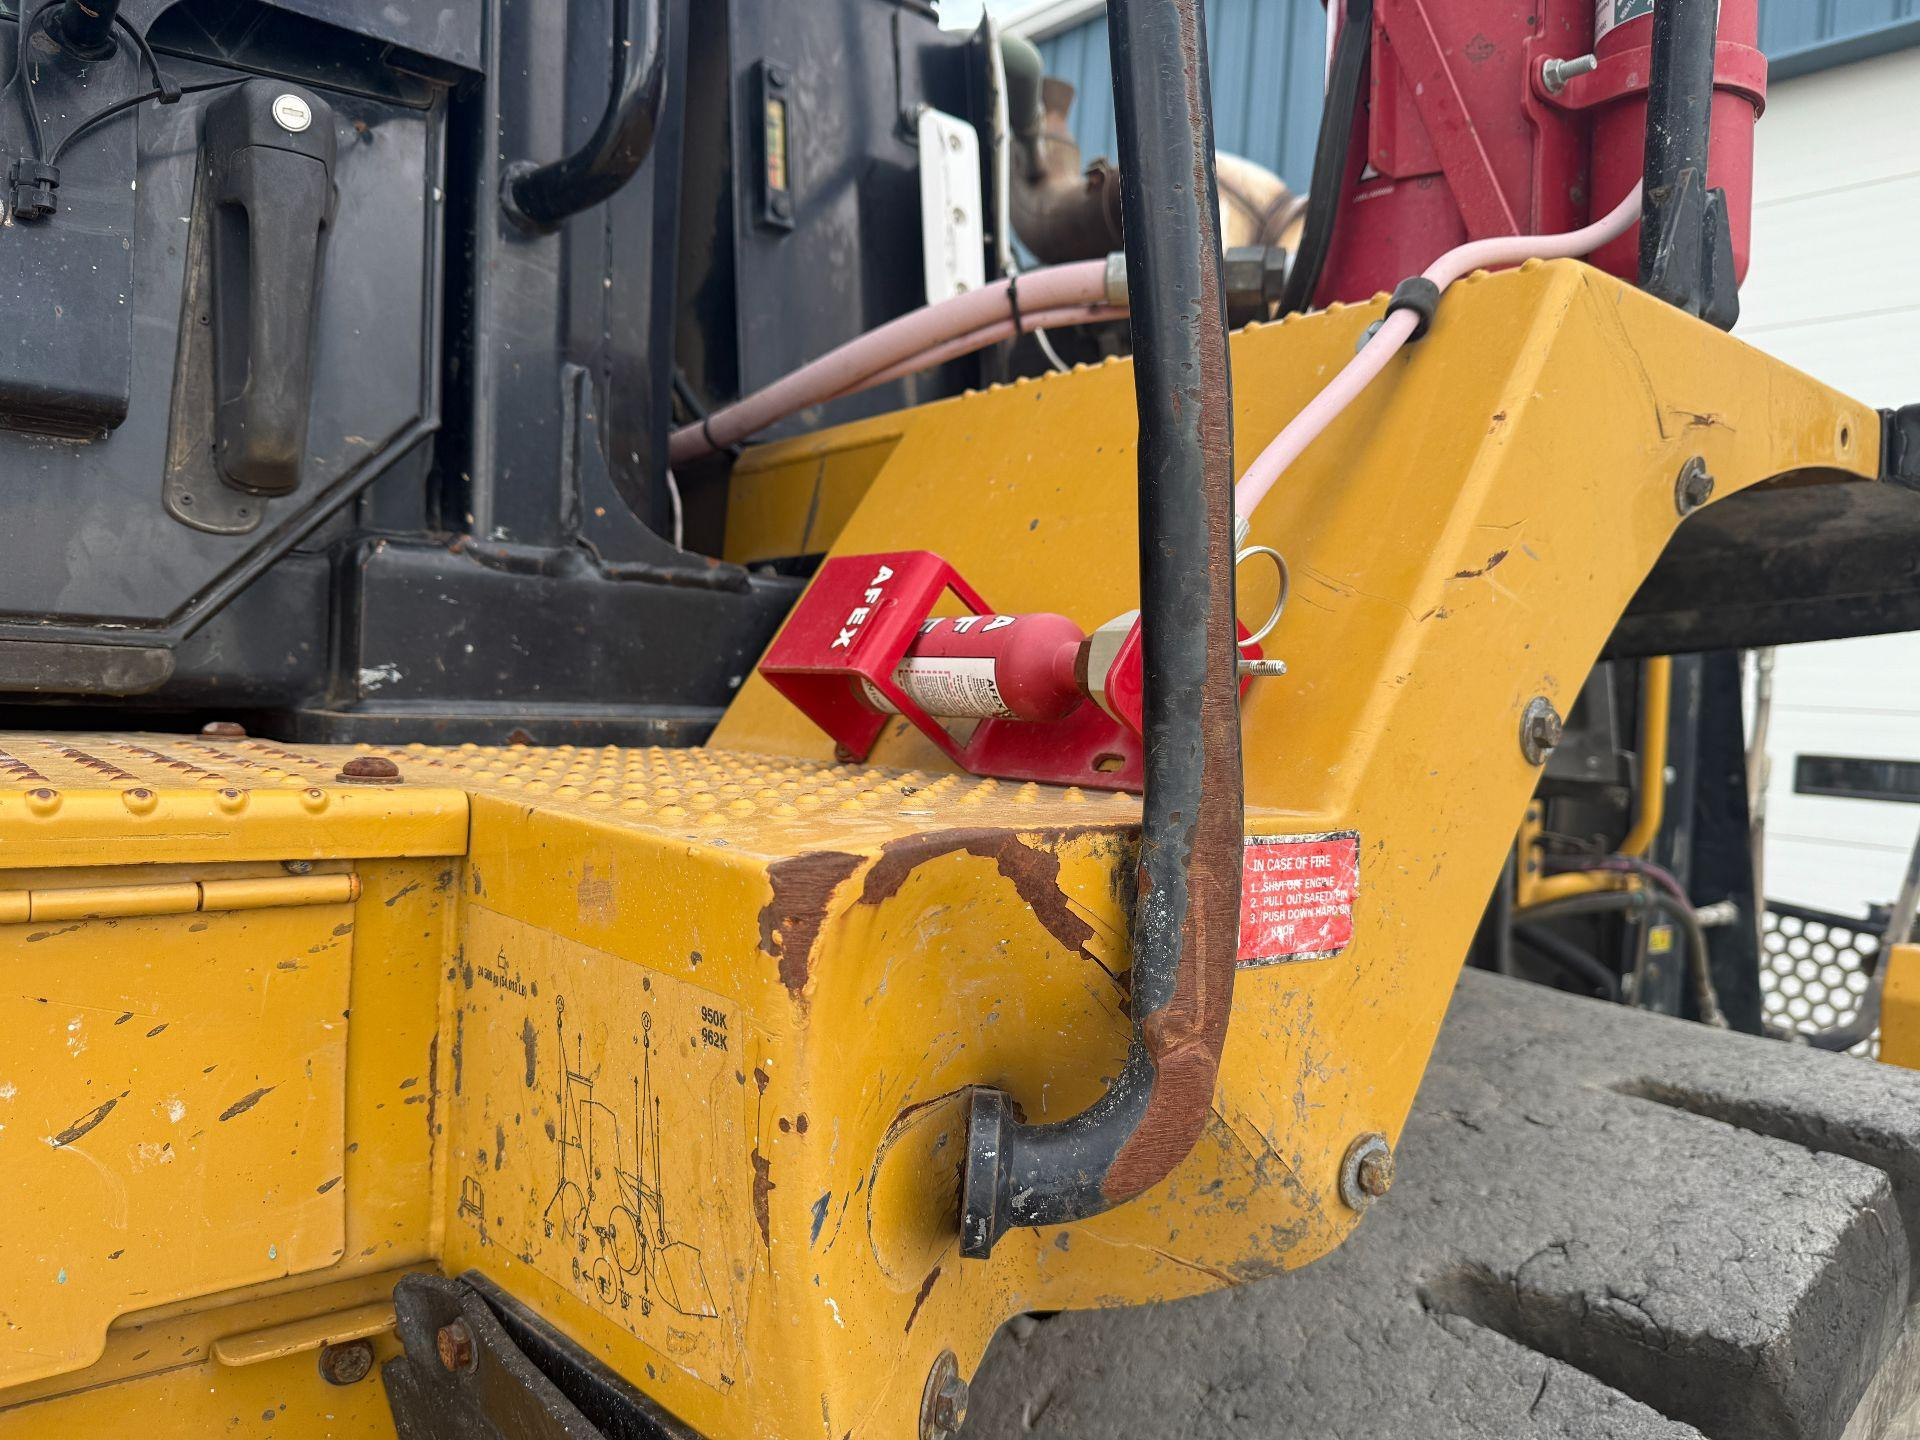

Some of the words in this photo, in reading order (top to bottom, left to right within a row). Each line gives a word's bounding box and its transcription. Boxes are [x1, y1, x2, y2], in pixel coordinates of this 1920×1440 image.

[831, 565, 894, 648] AFEX
[986, 678, 1004, 710] AFEX
[1253, 859, 1264, 872] IN
[1267, 857, 1293, 871] CASE
[1295, 857, 1308, 870] OF
[1310, 855, 1331, 868] FIRE
[1305, 876, 1334, 889] ENGINE
[1250, 897, 1258, 908] 2.
[1263, 896, 1284, 907] PULL
[1286, 894, 1302, 905] OUT
[1304, 891, 1333, 903] SAFETY
[1250, 913, 1258, 924] 3.
[1262, 910, 1286, 922] PUSH
[1288, 908, 1313, 920] DOWN
[1315, 905, 1337, 917] HARD
[1271, 925, 1295, 937] KNOB
[701, 1005, 728, 1030] 950K
[701, 1027, 728, 1051] 962K
